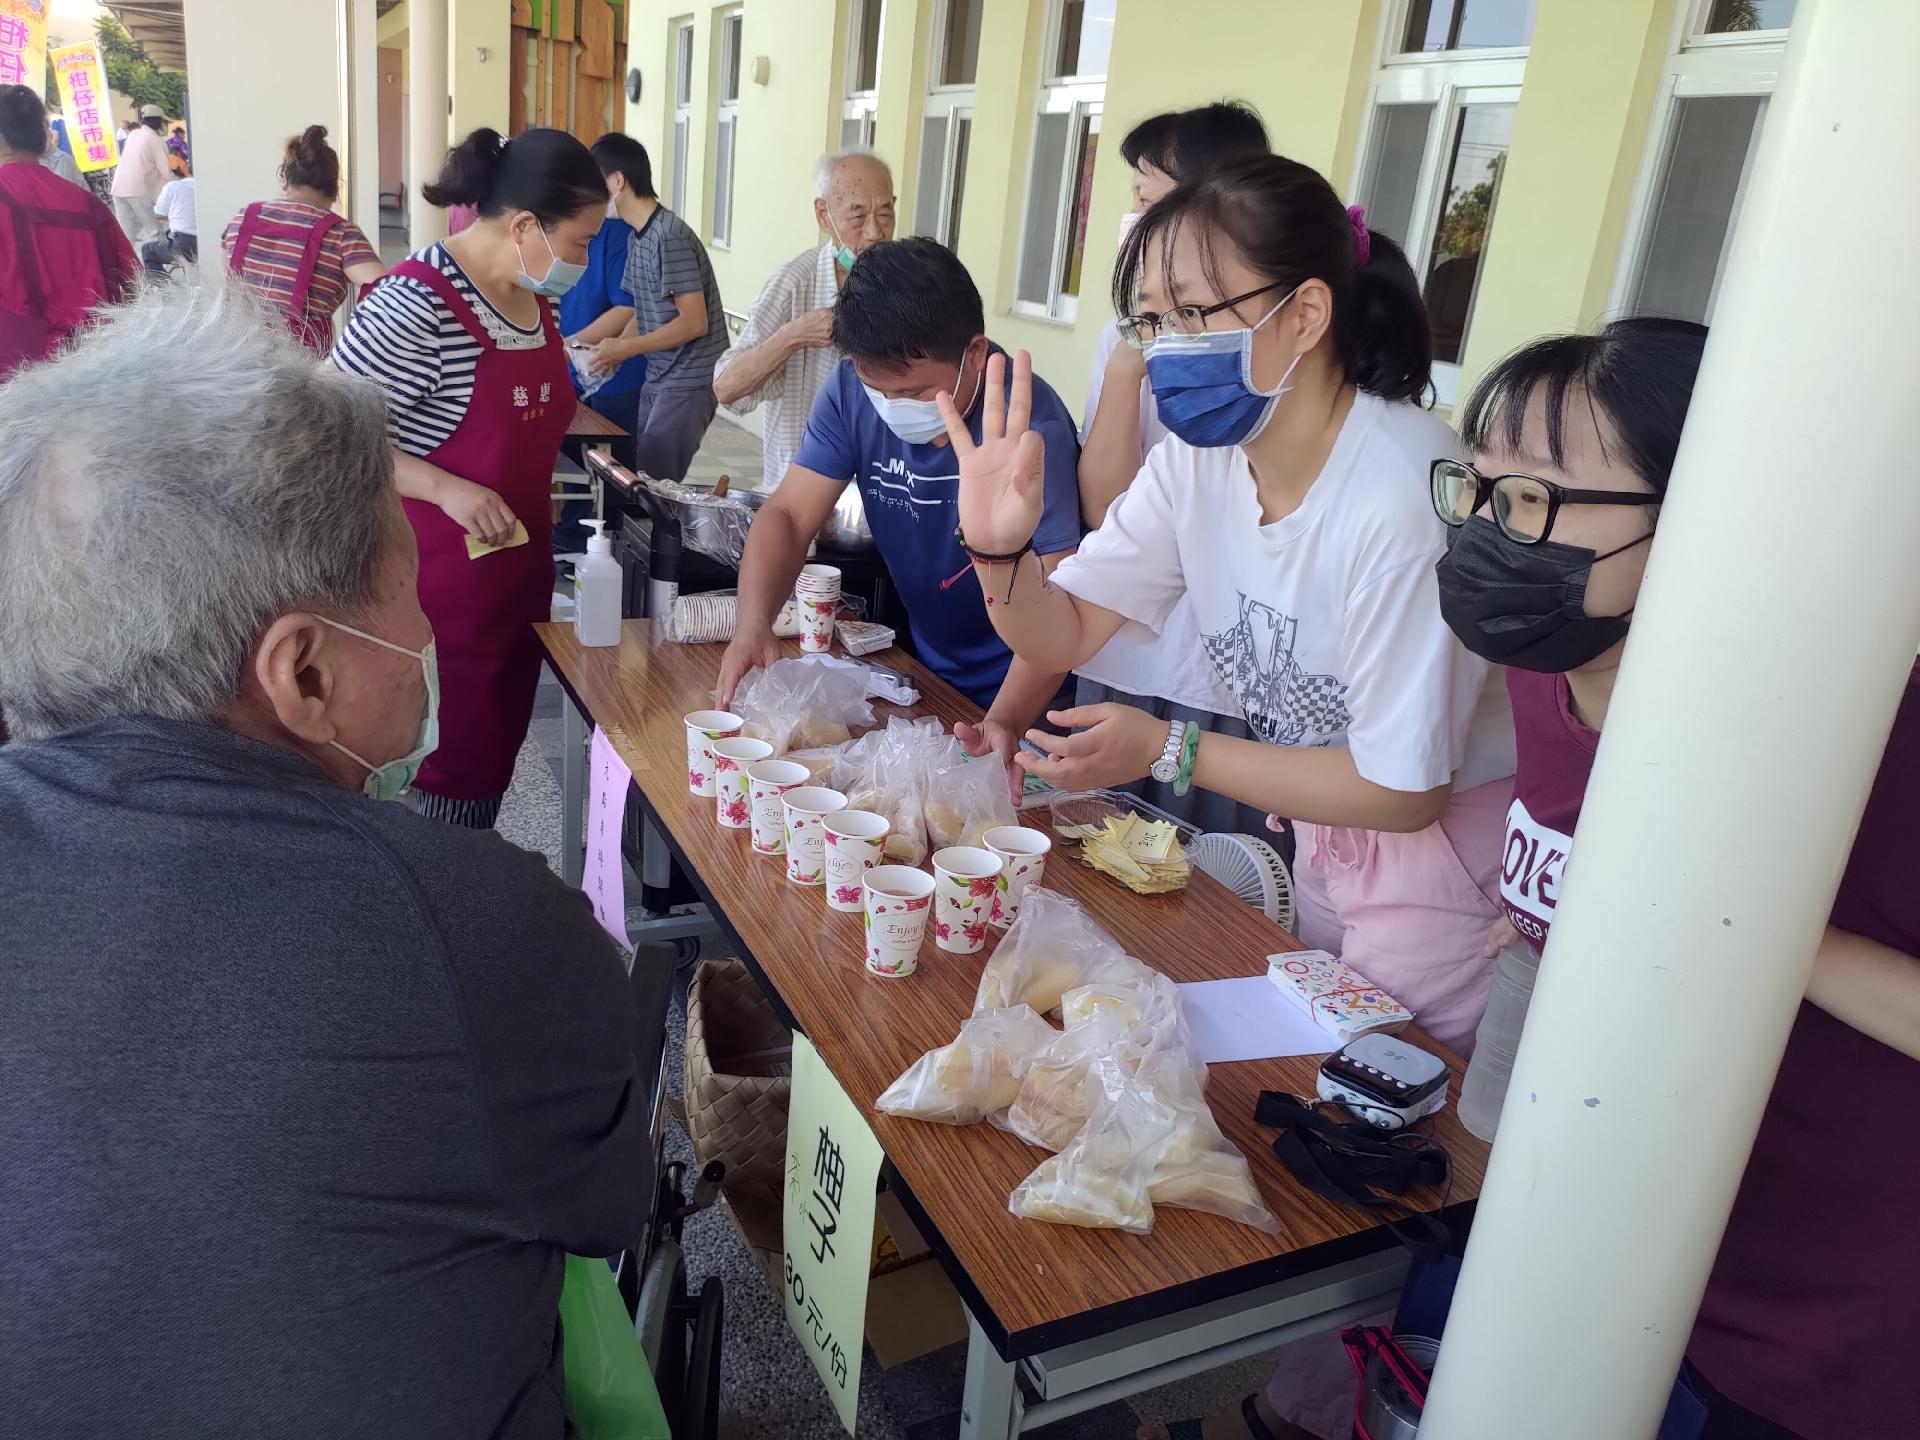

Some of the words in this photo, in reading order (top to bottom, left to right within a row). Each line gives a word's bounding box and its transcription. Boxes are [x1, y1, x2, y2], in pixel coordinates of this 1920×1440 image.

[69, 71, 110, 161] 柑仔店市集
[1503, 816, 1567, 909] OVE
[886, 924, 919, 937] Enjoy
[1508, 908, 1542, 941] KEEP
[808, 1125, 845, 1264] 柚子
